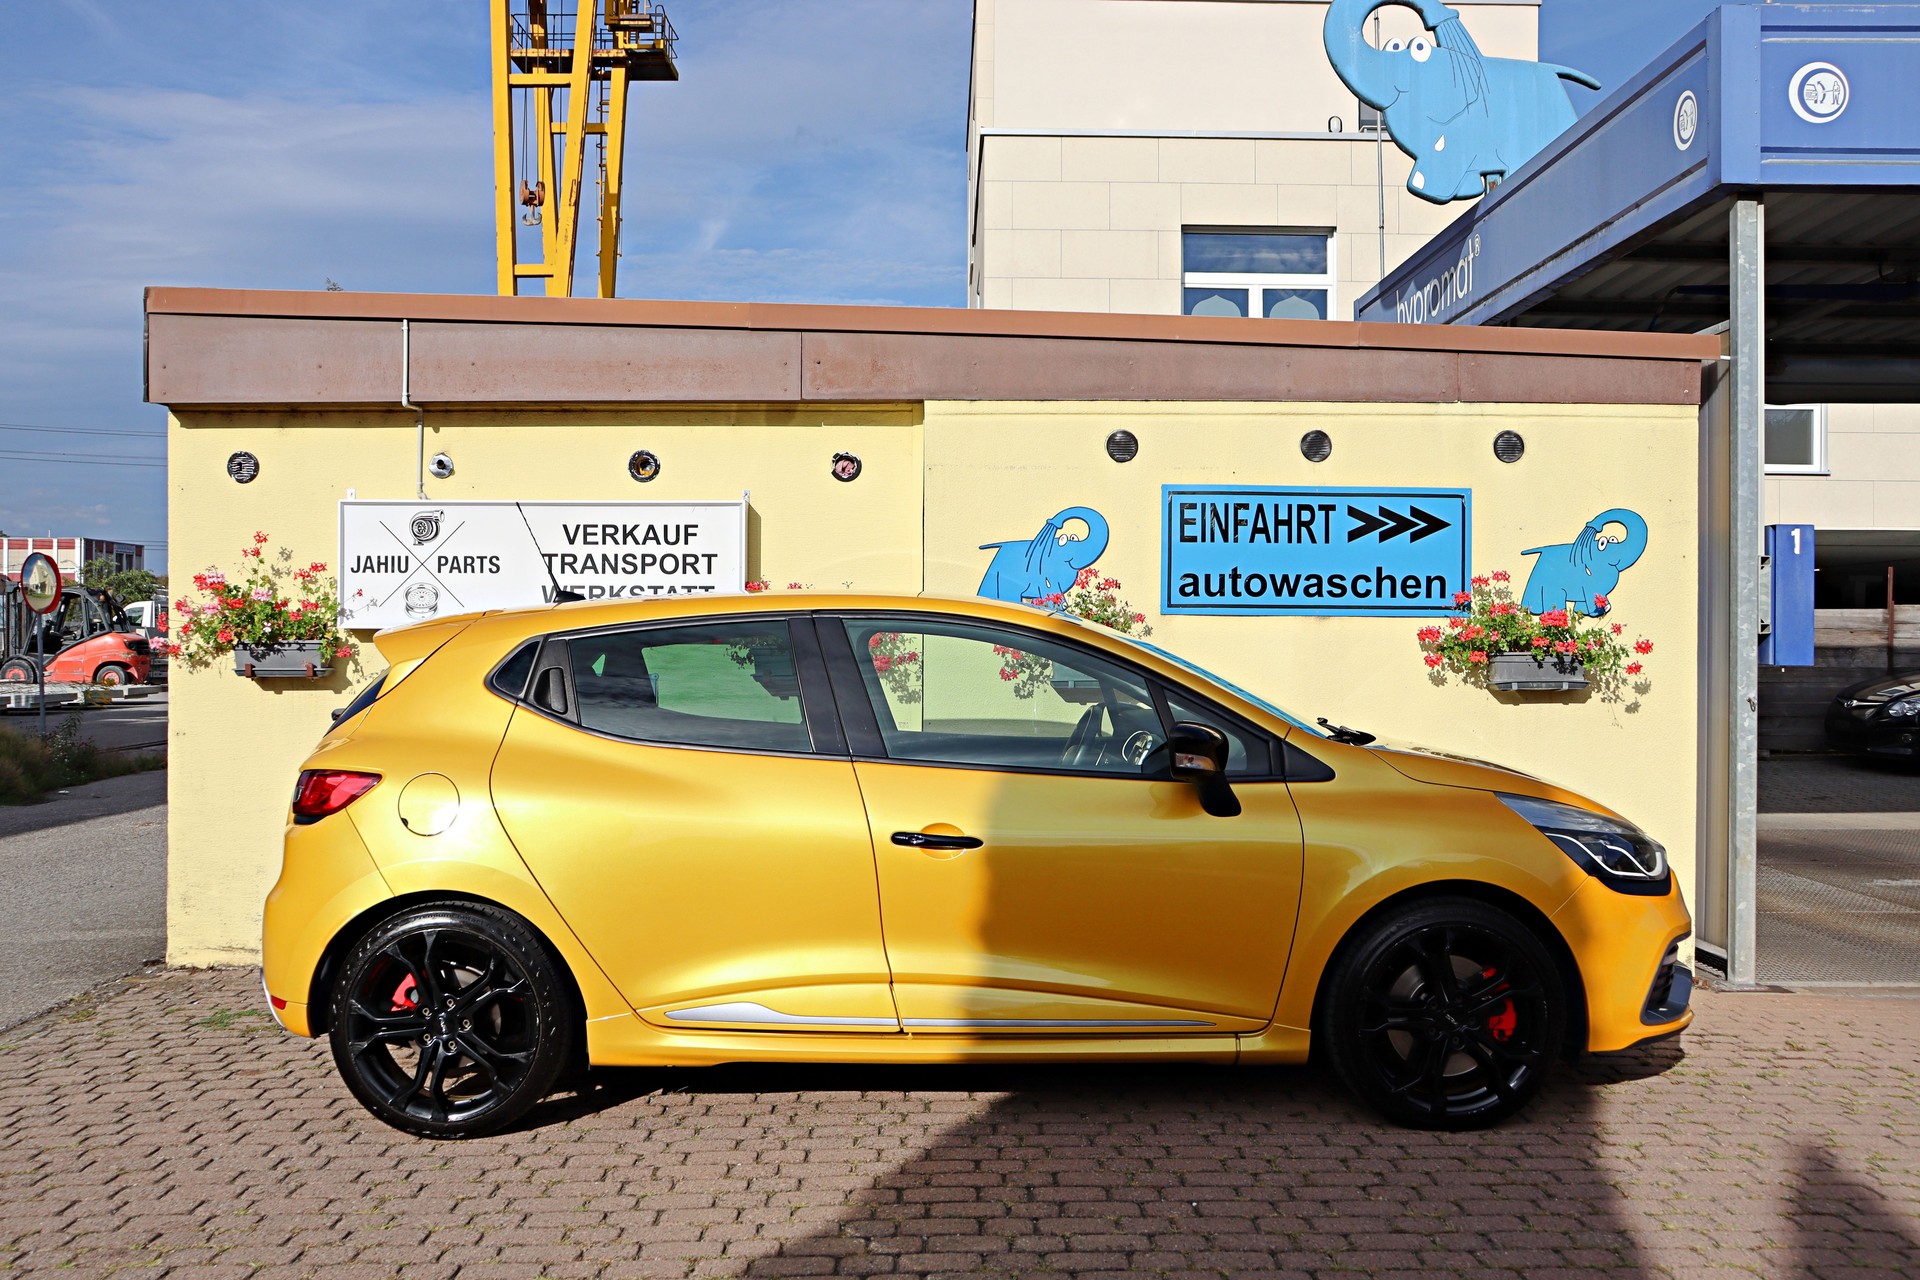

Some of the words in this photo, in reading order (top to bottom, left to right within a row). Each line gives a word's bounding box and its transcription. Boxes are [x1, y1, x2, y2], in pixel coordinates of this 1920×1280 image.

[563, 523, 699, 546] VERKAUF
[1179, 502, 1336, 544] EINFAHRT
[1791, 528, 1801, 554] 1
[350, 555, 409, 574] JAHIU
[437, 555, 502, 574] PARTS
[543, 553, 718, 575] TRANSPORT
[1178, 566, 1447, 599] autowaschen
